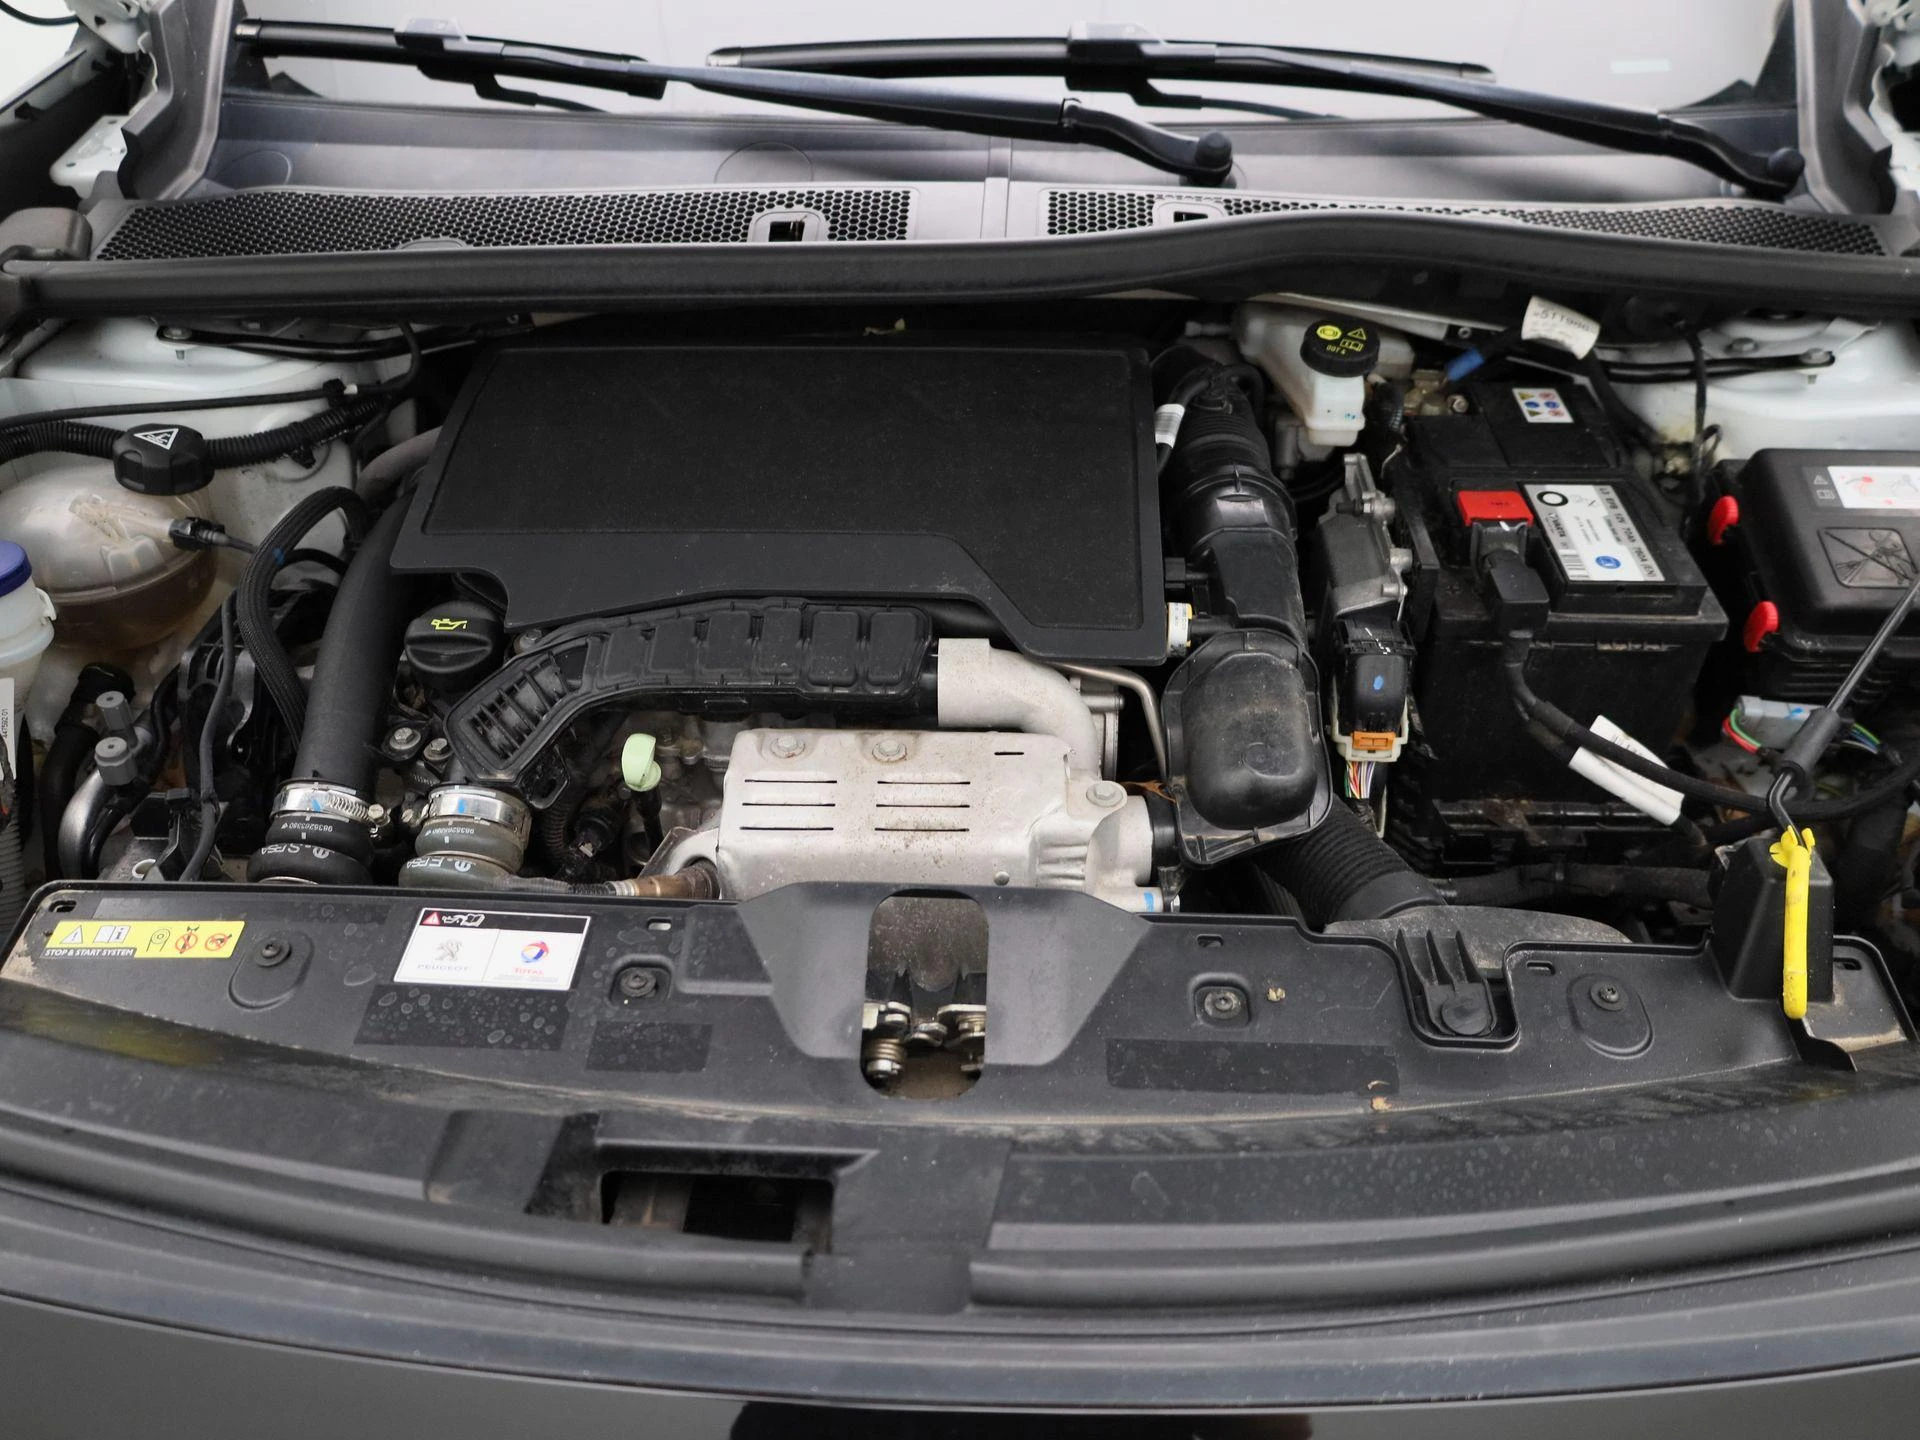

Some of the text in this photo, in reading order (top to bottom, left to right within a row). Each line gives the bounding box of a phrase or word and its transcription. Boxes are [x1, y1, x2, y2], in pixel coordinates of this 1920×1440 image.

[45, 948, 68, 957] STOP
[76, 948, 100, 957] START
[101, 949, 134, 957] SYSTEM
[513, 967, 544, 975] TOTAL
